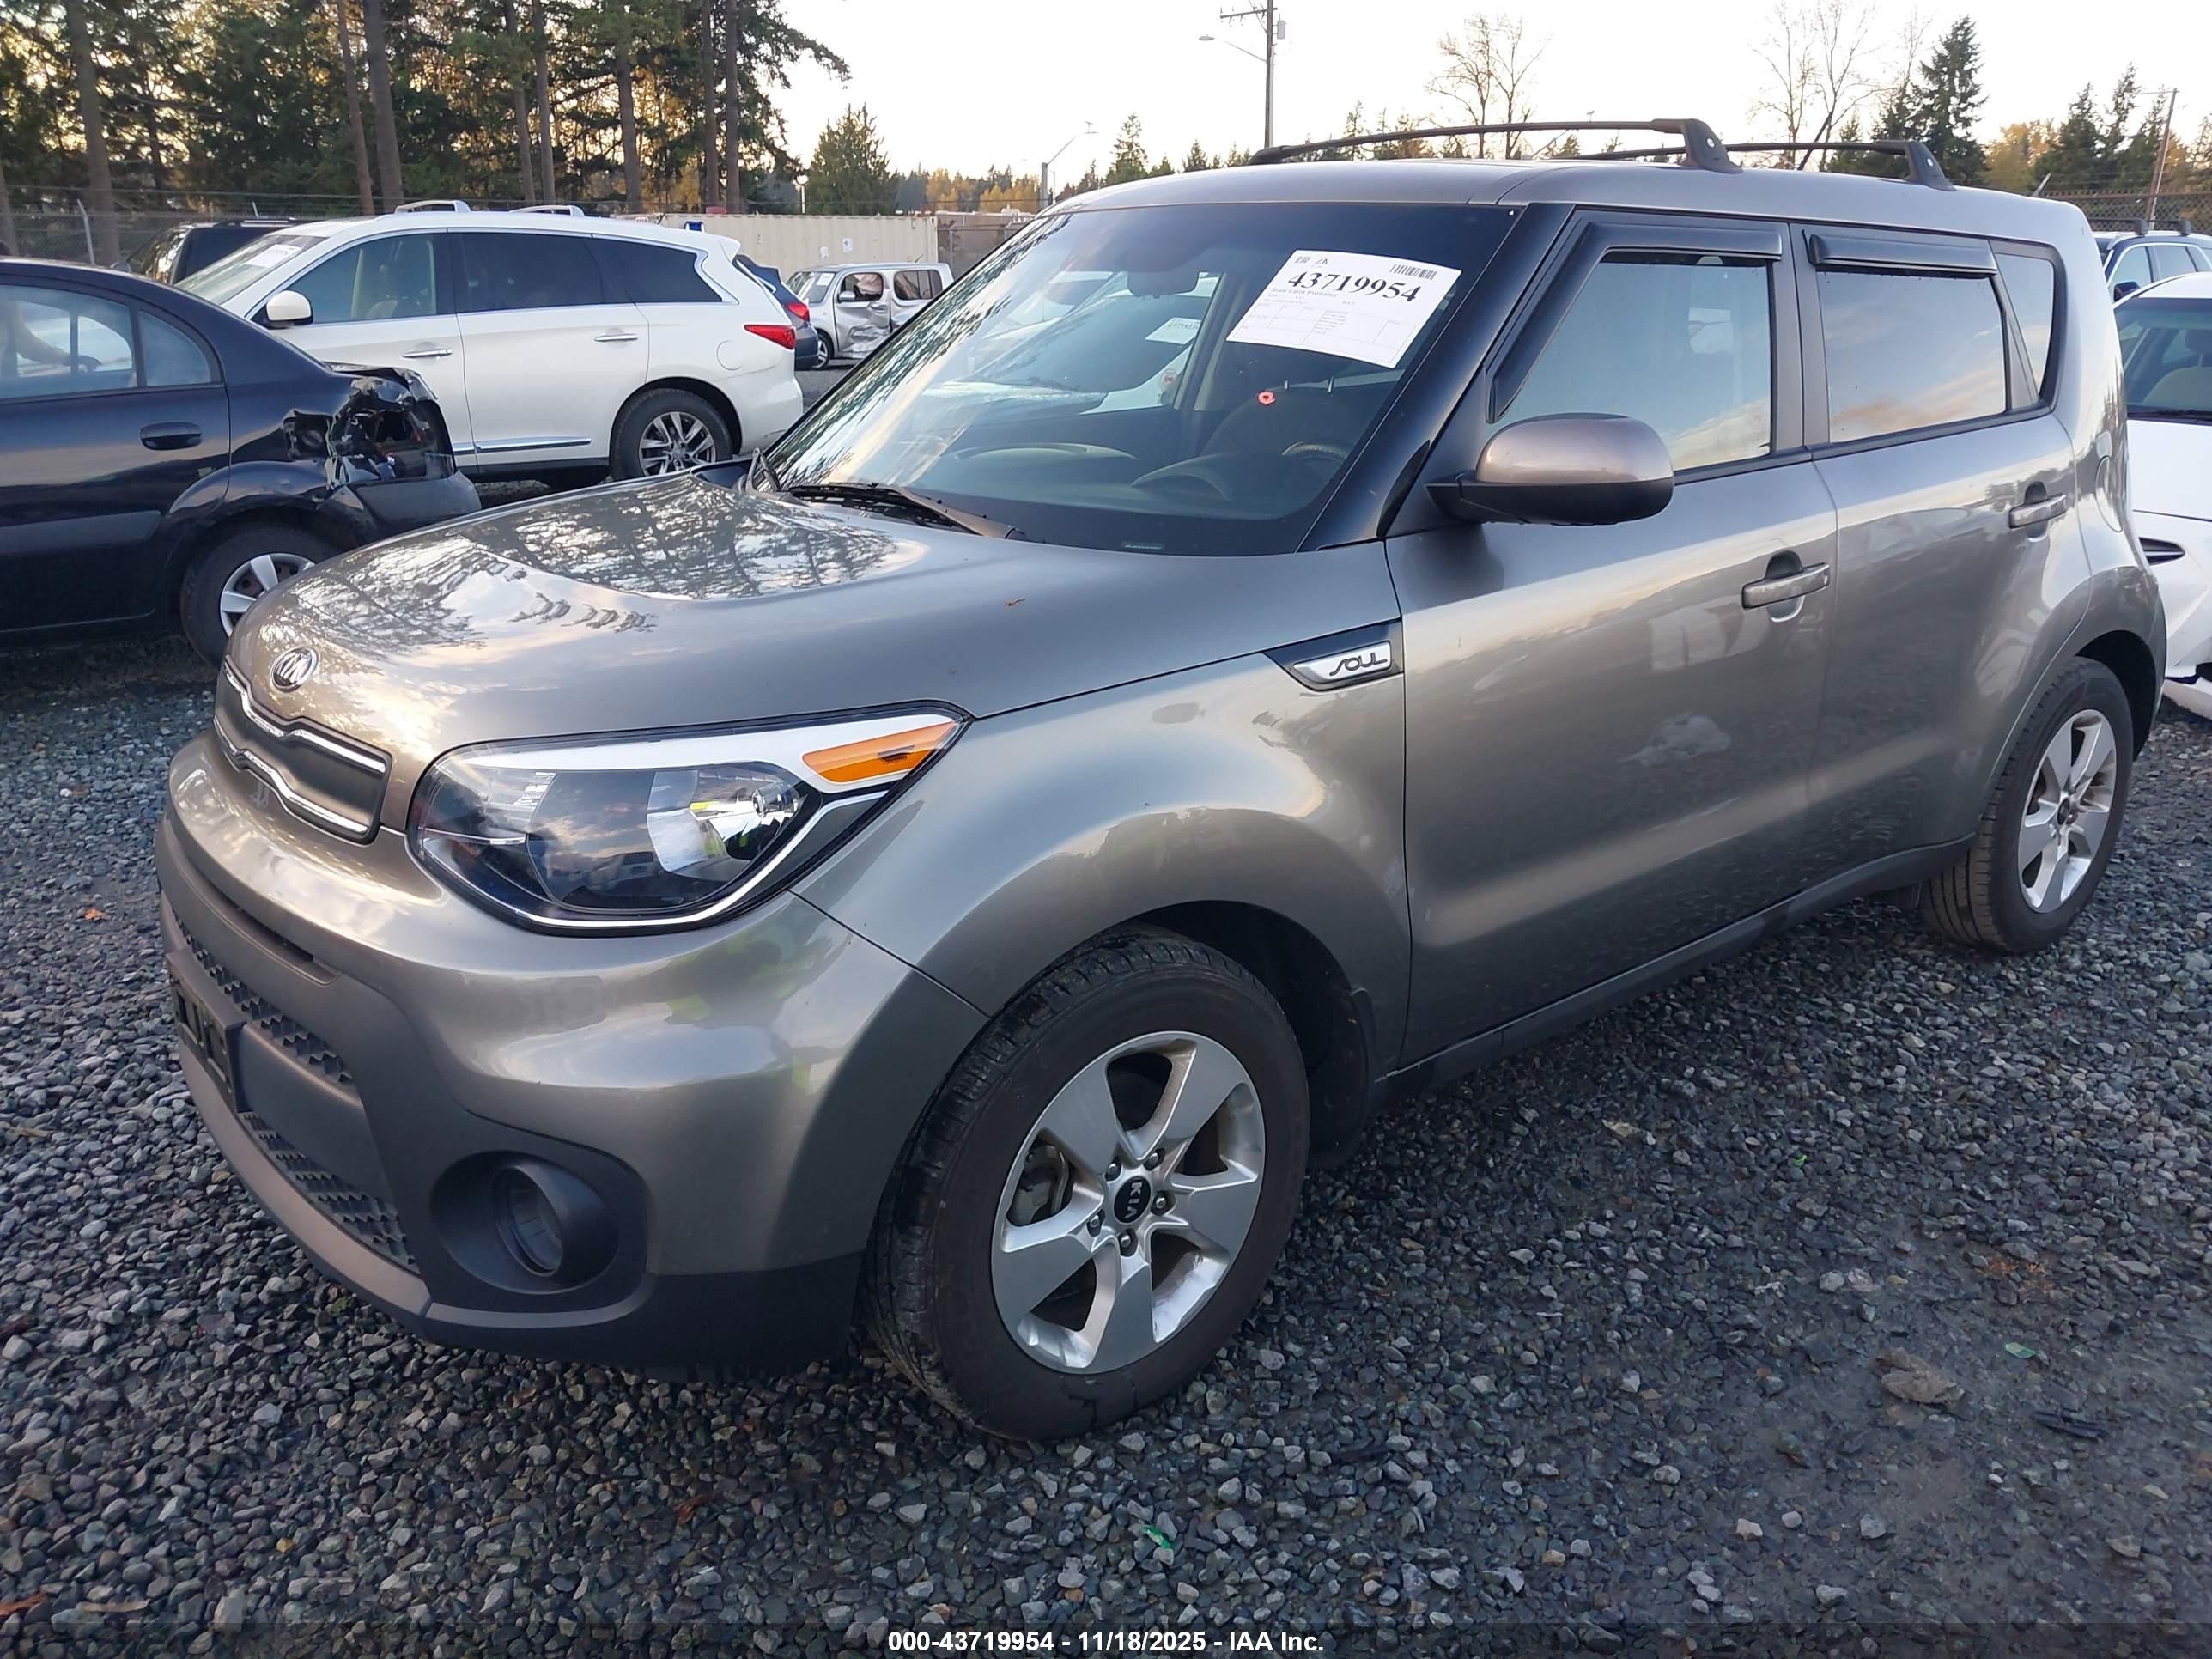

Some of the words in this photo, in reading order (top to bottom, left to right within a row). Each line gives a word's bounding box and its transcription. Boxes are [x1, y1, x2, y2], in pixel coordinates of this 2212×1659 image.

[1288, 271, 1422, 301] 43719954
[1307, 289, 1339, 298] Insurance
[1329, 652, 1388, 677] SOUL
[1125, 1182, 1143, 1218] KIA
